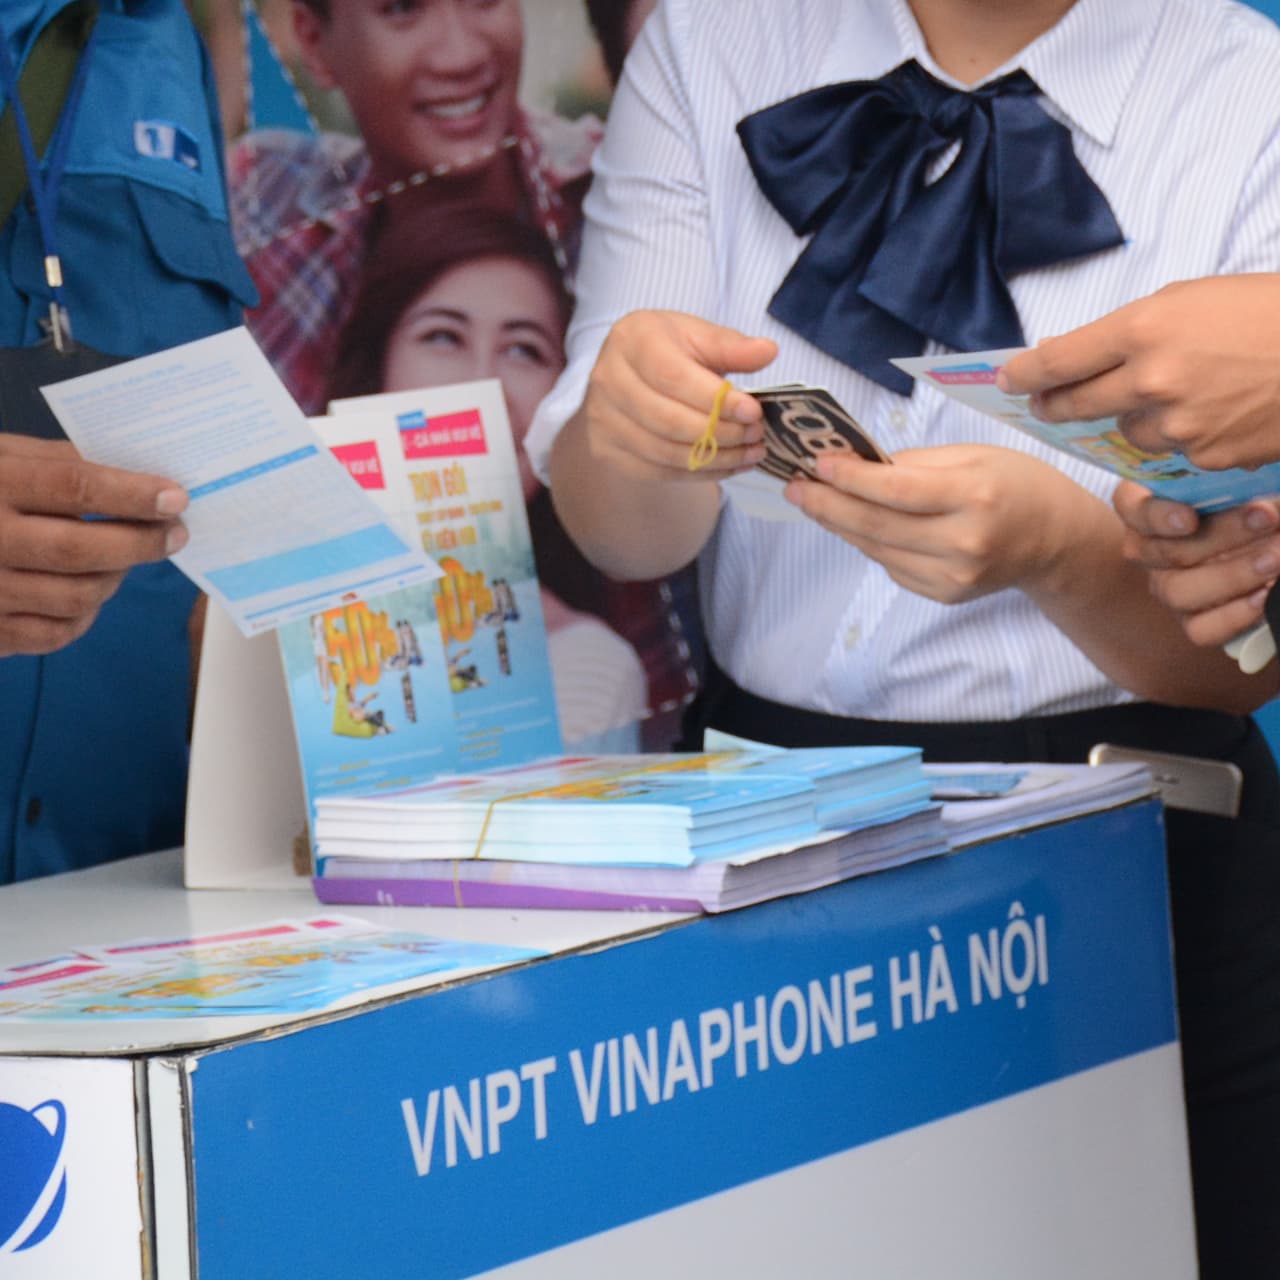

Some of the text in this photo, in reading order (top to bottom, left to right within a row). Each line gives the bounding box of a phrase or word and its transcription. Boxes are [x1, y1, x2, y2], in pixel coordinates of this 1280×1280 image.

[401, 901, 1050, 1178] VNPT VINAPHONE HÀ NỘI
